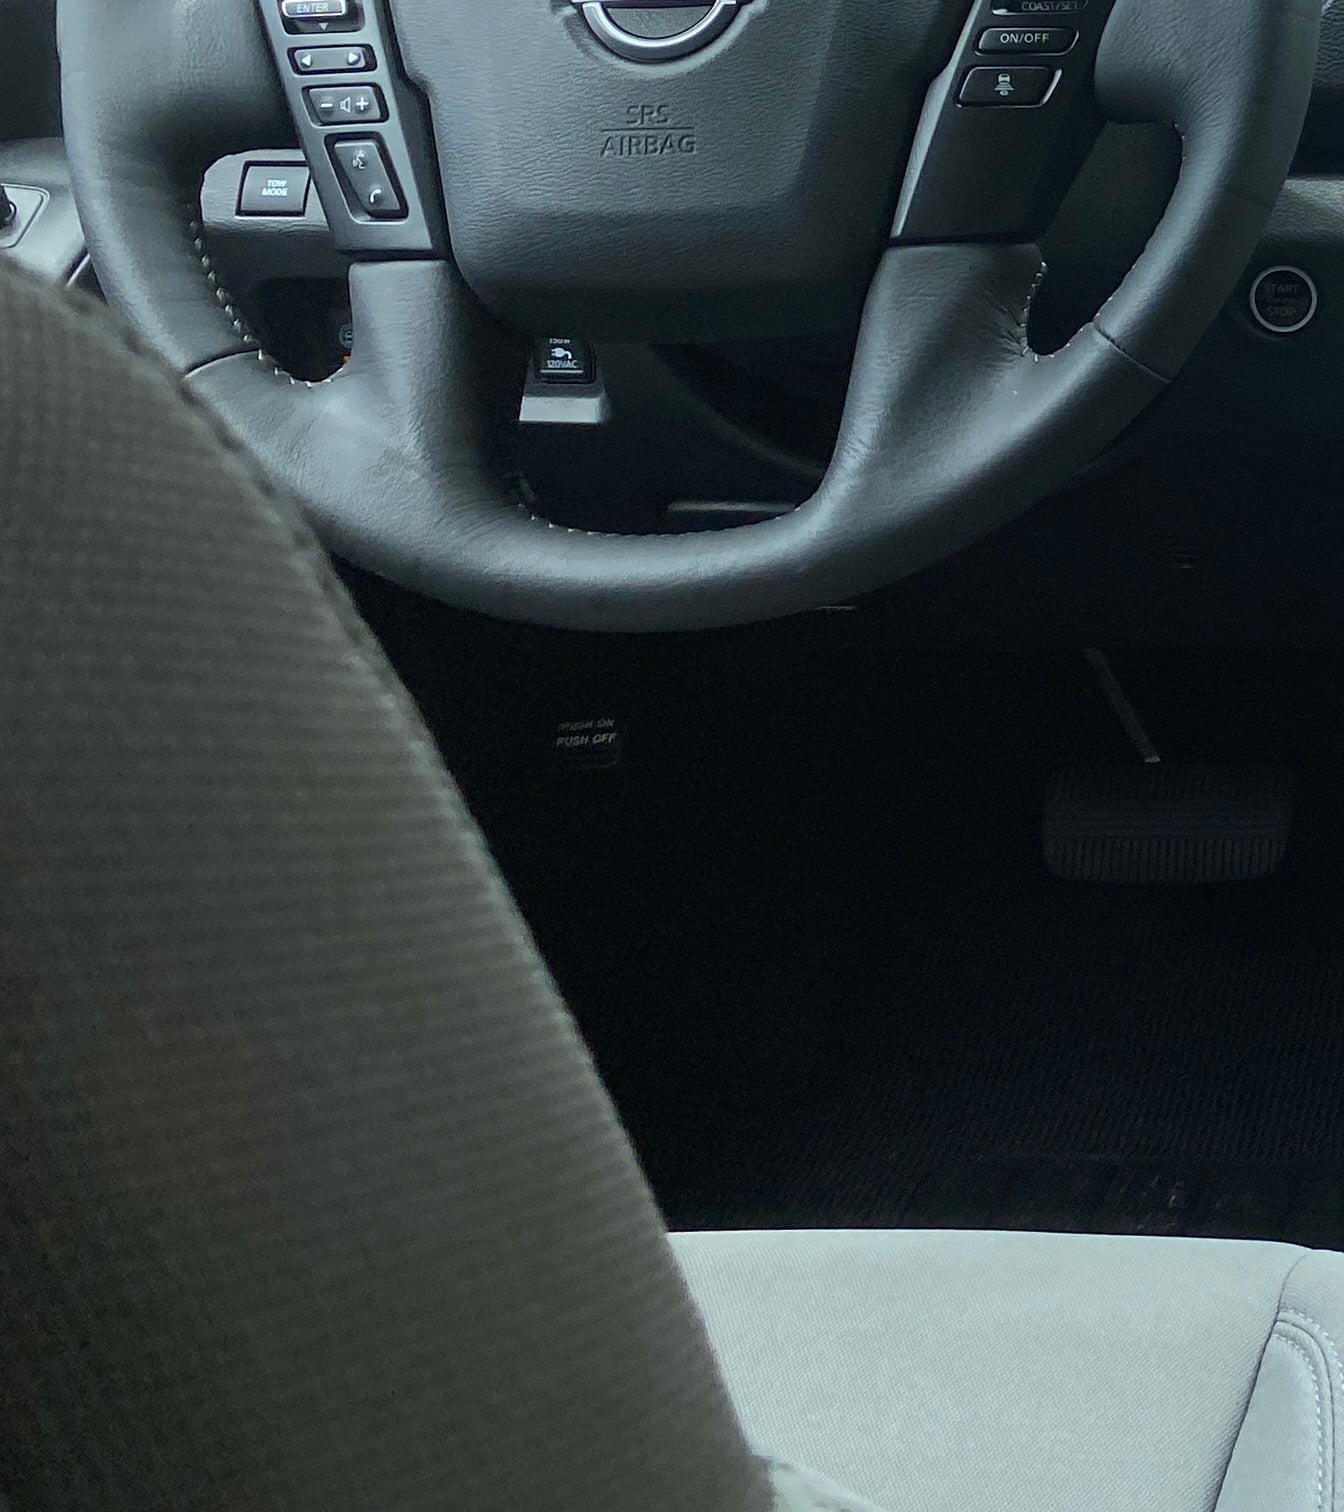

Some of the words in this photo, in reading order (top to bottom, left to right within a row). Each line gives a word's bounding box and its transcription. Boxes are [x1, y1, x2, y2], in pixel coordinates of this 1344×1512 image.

[296, 2, 329, 13] ENTER
[1021, 1, 1078, 11] COAST/SET
[1000, 33, 1050, 44] ON/OFF
[626, 104, 671, 125] SRS
[600, 134, 696, 158] AIRBAG
[267, 179, 287, 187] TOW
[262, 188, 288, 196] MODE
[556, 735, 589, 748] PUSH
